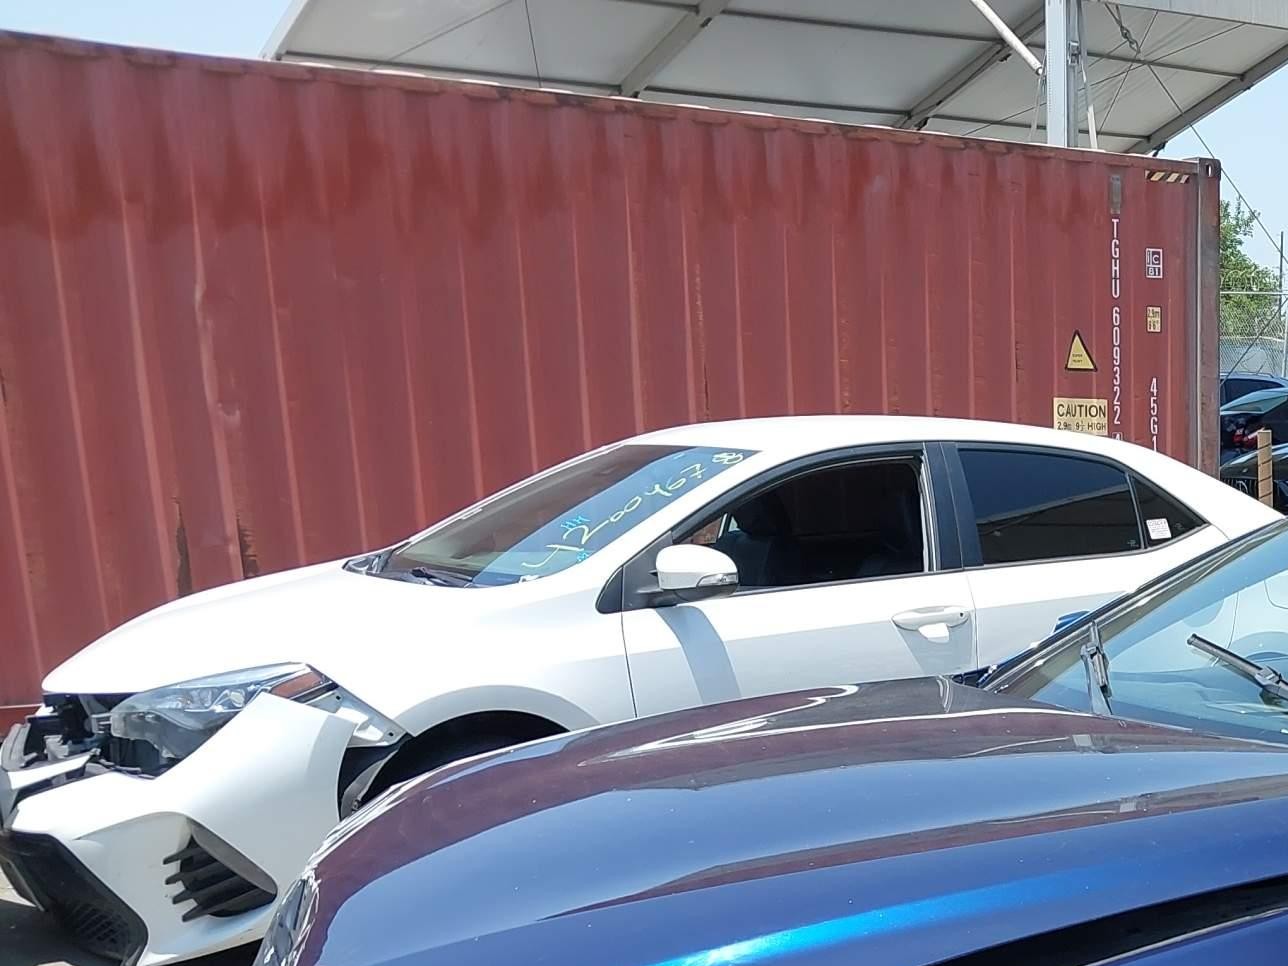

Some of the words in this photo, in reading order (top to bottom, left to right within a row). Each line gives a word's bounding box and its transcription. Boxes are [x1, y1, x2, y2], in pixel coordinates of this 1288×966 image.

[1111, 218, 1120, 298] TGHU
[1112, 307, 1121, 425] 609322
[1056, 404, 1106, 418] CAUTION
[1087, 423, 1107, 431] HIGH
[1150, 377, 1158, 451] 45G1
